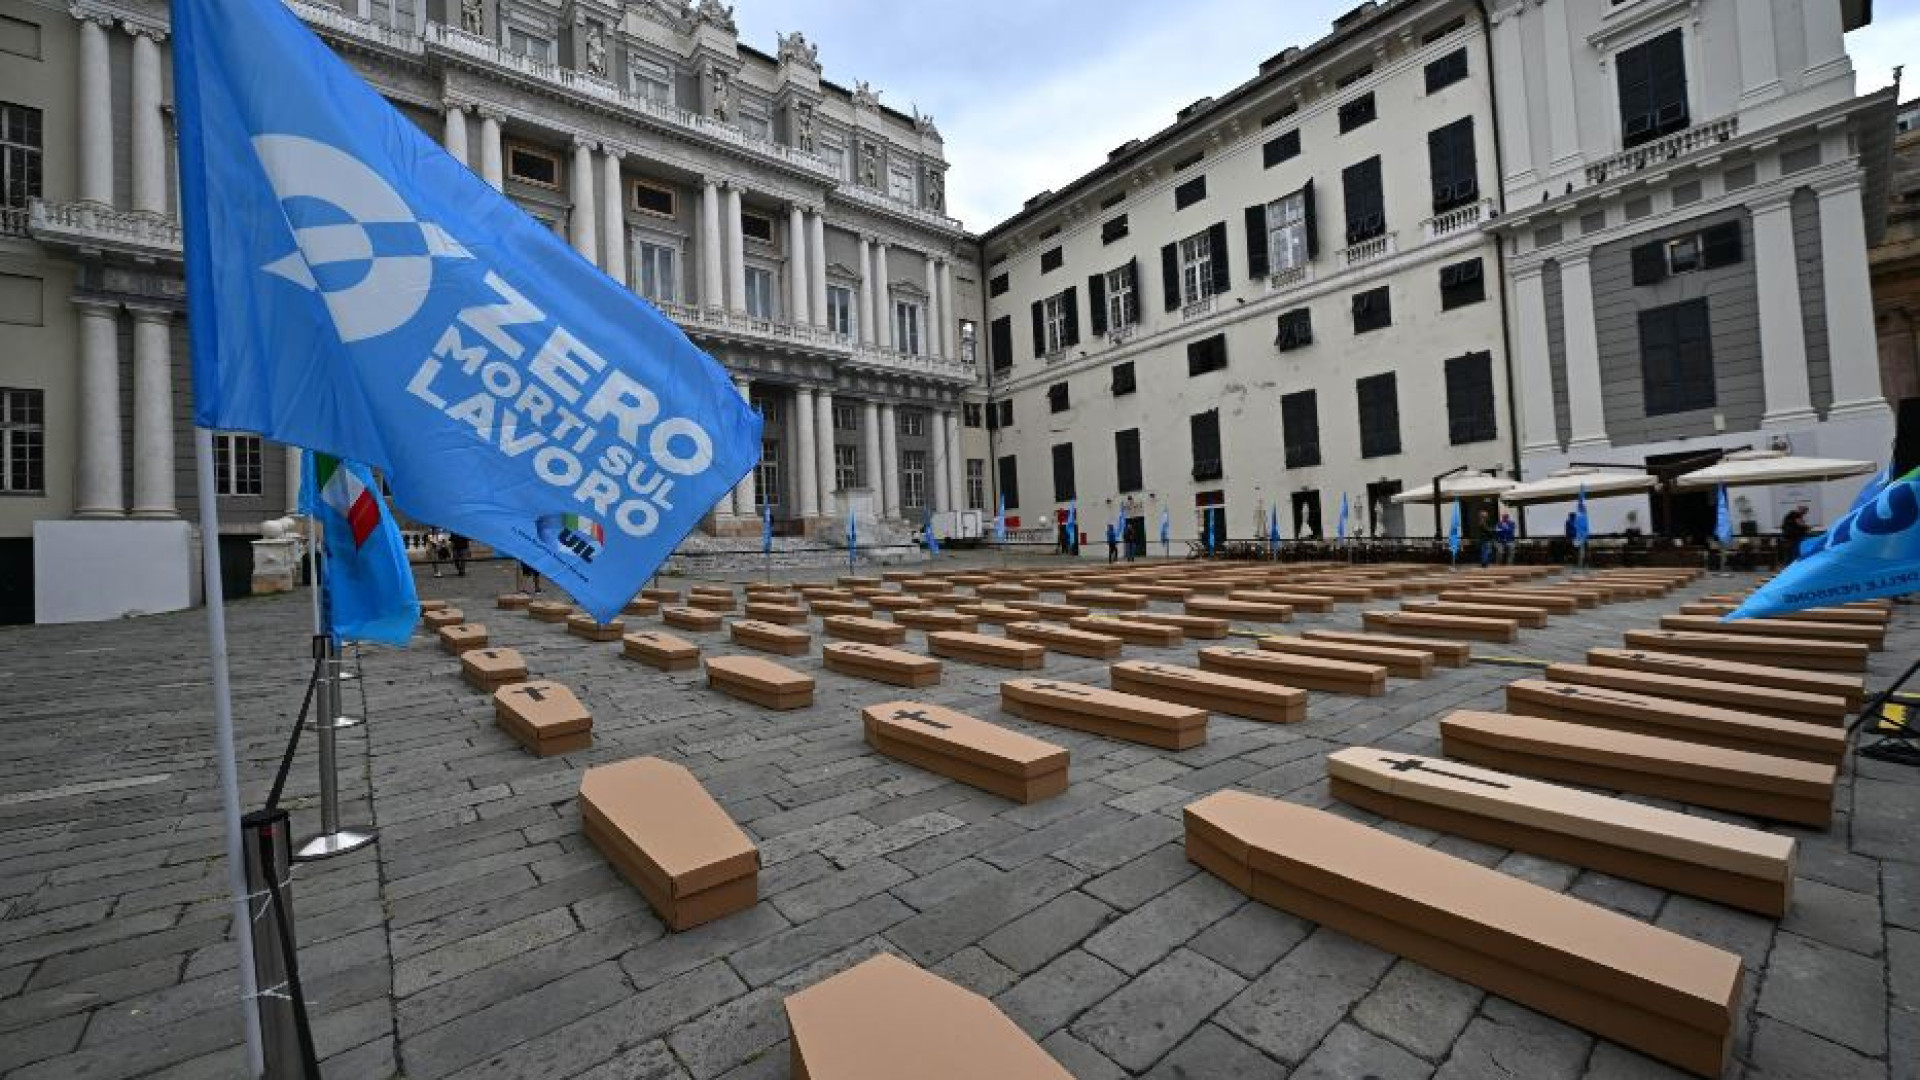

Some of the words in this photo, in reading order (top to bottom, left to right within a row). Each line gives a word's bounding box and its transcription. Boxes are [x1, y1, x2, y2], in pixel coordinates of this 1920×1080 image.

[406, 358, 660, 536] LAVORO
[432, 325, 597, 453] MORTI
[599, 446, 675, 511] SUL
[457, 270, 713, 475] ZERO
[558, 528, 596, 563] UIL
